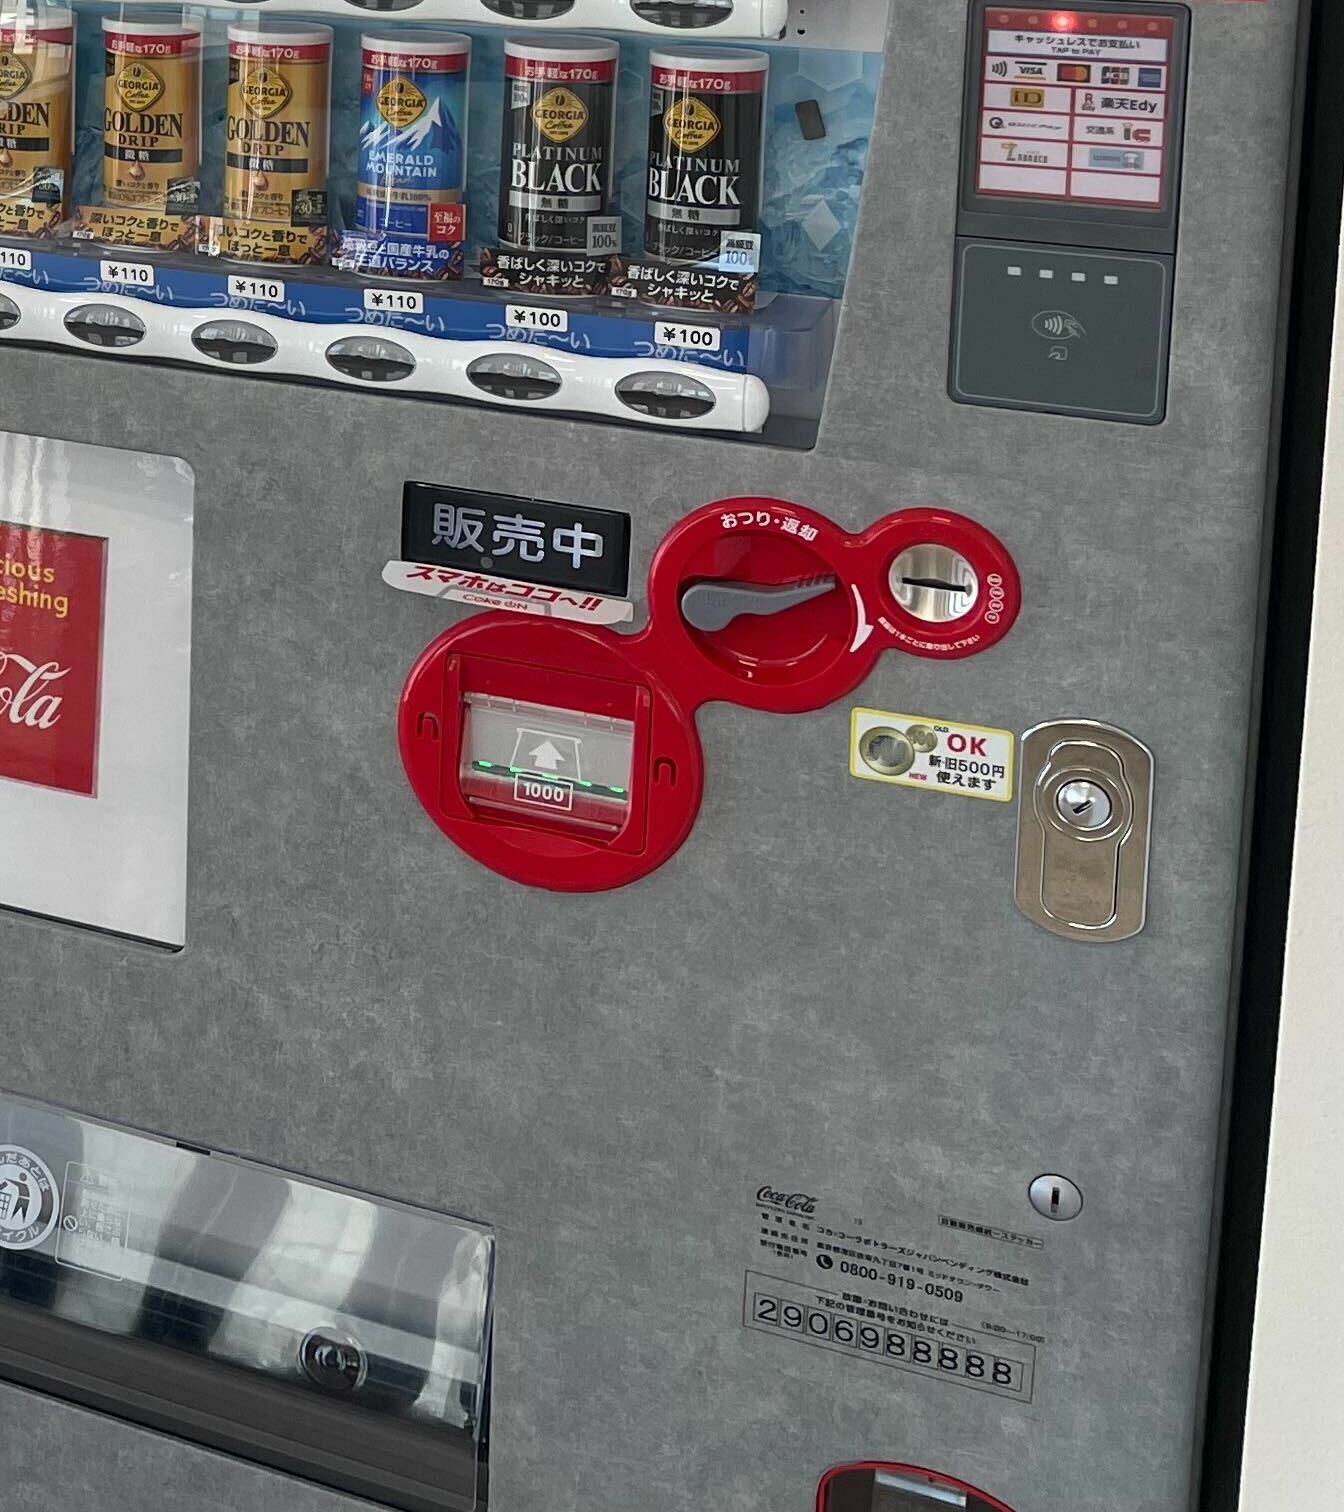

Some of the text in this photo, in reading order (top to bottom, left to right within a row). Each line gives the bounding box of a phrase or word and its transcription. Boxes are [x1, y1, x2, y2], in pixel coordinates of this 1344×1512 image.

[1101, 97, 1157, 113] 楽天Edy
[104, 113, 183, 138] GOLDEN
[228, 121, 310, 146] GOLDEN
[119, 134, 159, 147] DRIP
[242, 143, 284, 155] DRIP
[369, 151, 434, 167] EMERALD
[513, 142, 602, 162] PLATINUM
[366, 163, 437, 179] MOUNTAIN
[650, 155, 740, 174] PLATINUM
[511, 162, 601, 193] BLACK
[648, 174, 741, 206] BLACK
[90, 212, 179, 232] 深いコクと香りで
[102, 228, 161, 242] ほっと一息
[497, 256, 605, 274] 香ばしく深いコクで
[235, 280, 278, 298] ¥110
[519, 272, 582, 288] シャキッと
[371, 294, 417, 309] ¥110
[513, 311, 561, 327] ¥100
[663, 328, 713, 345] ¥100
[431, 503, 603, 568] 販売中
[947, 734, 986, 756] OK
[936, 771, 996, 790] 使えます
[523, 782, 564, 803] 1000
[840, 1261, 964, 1303] 0800-919-0509
[757, 1298, 1012, 1386] 2906988888
